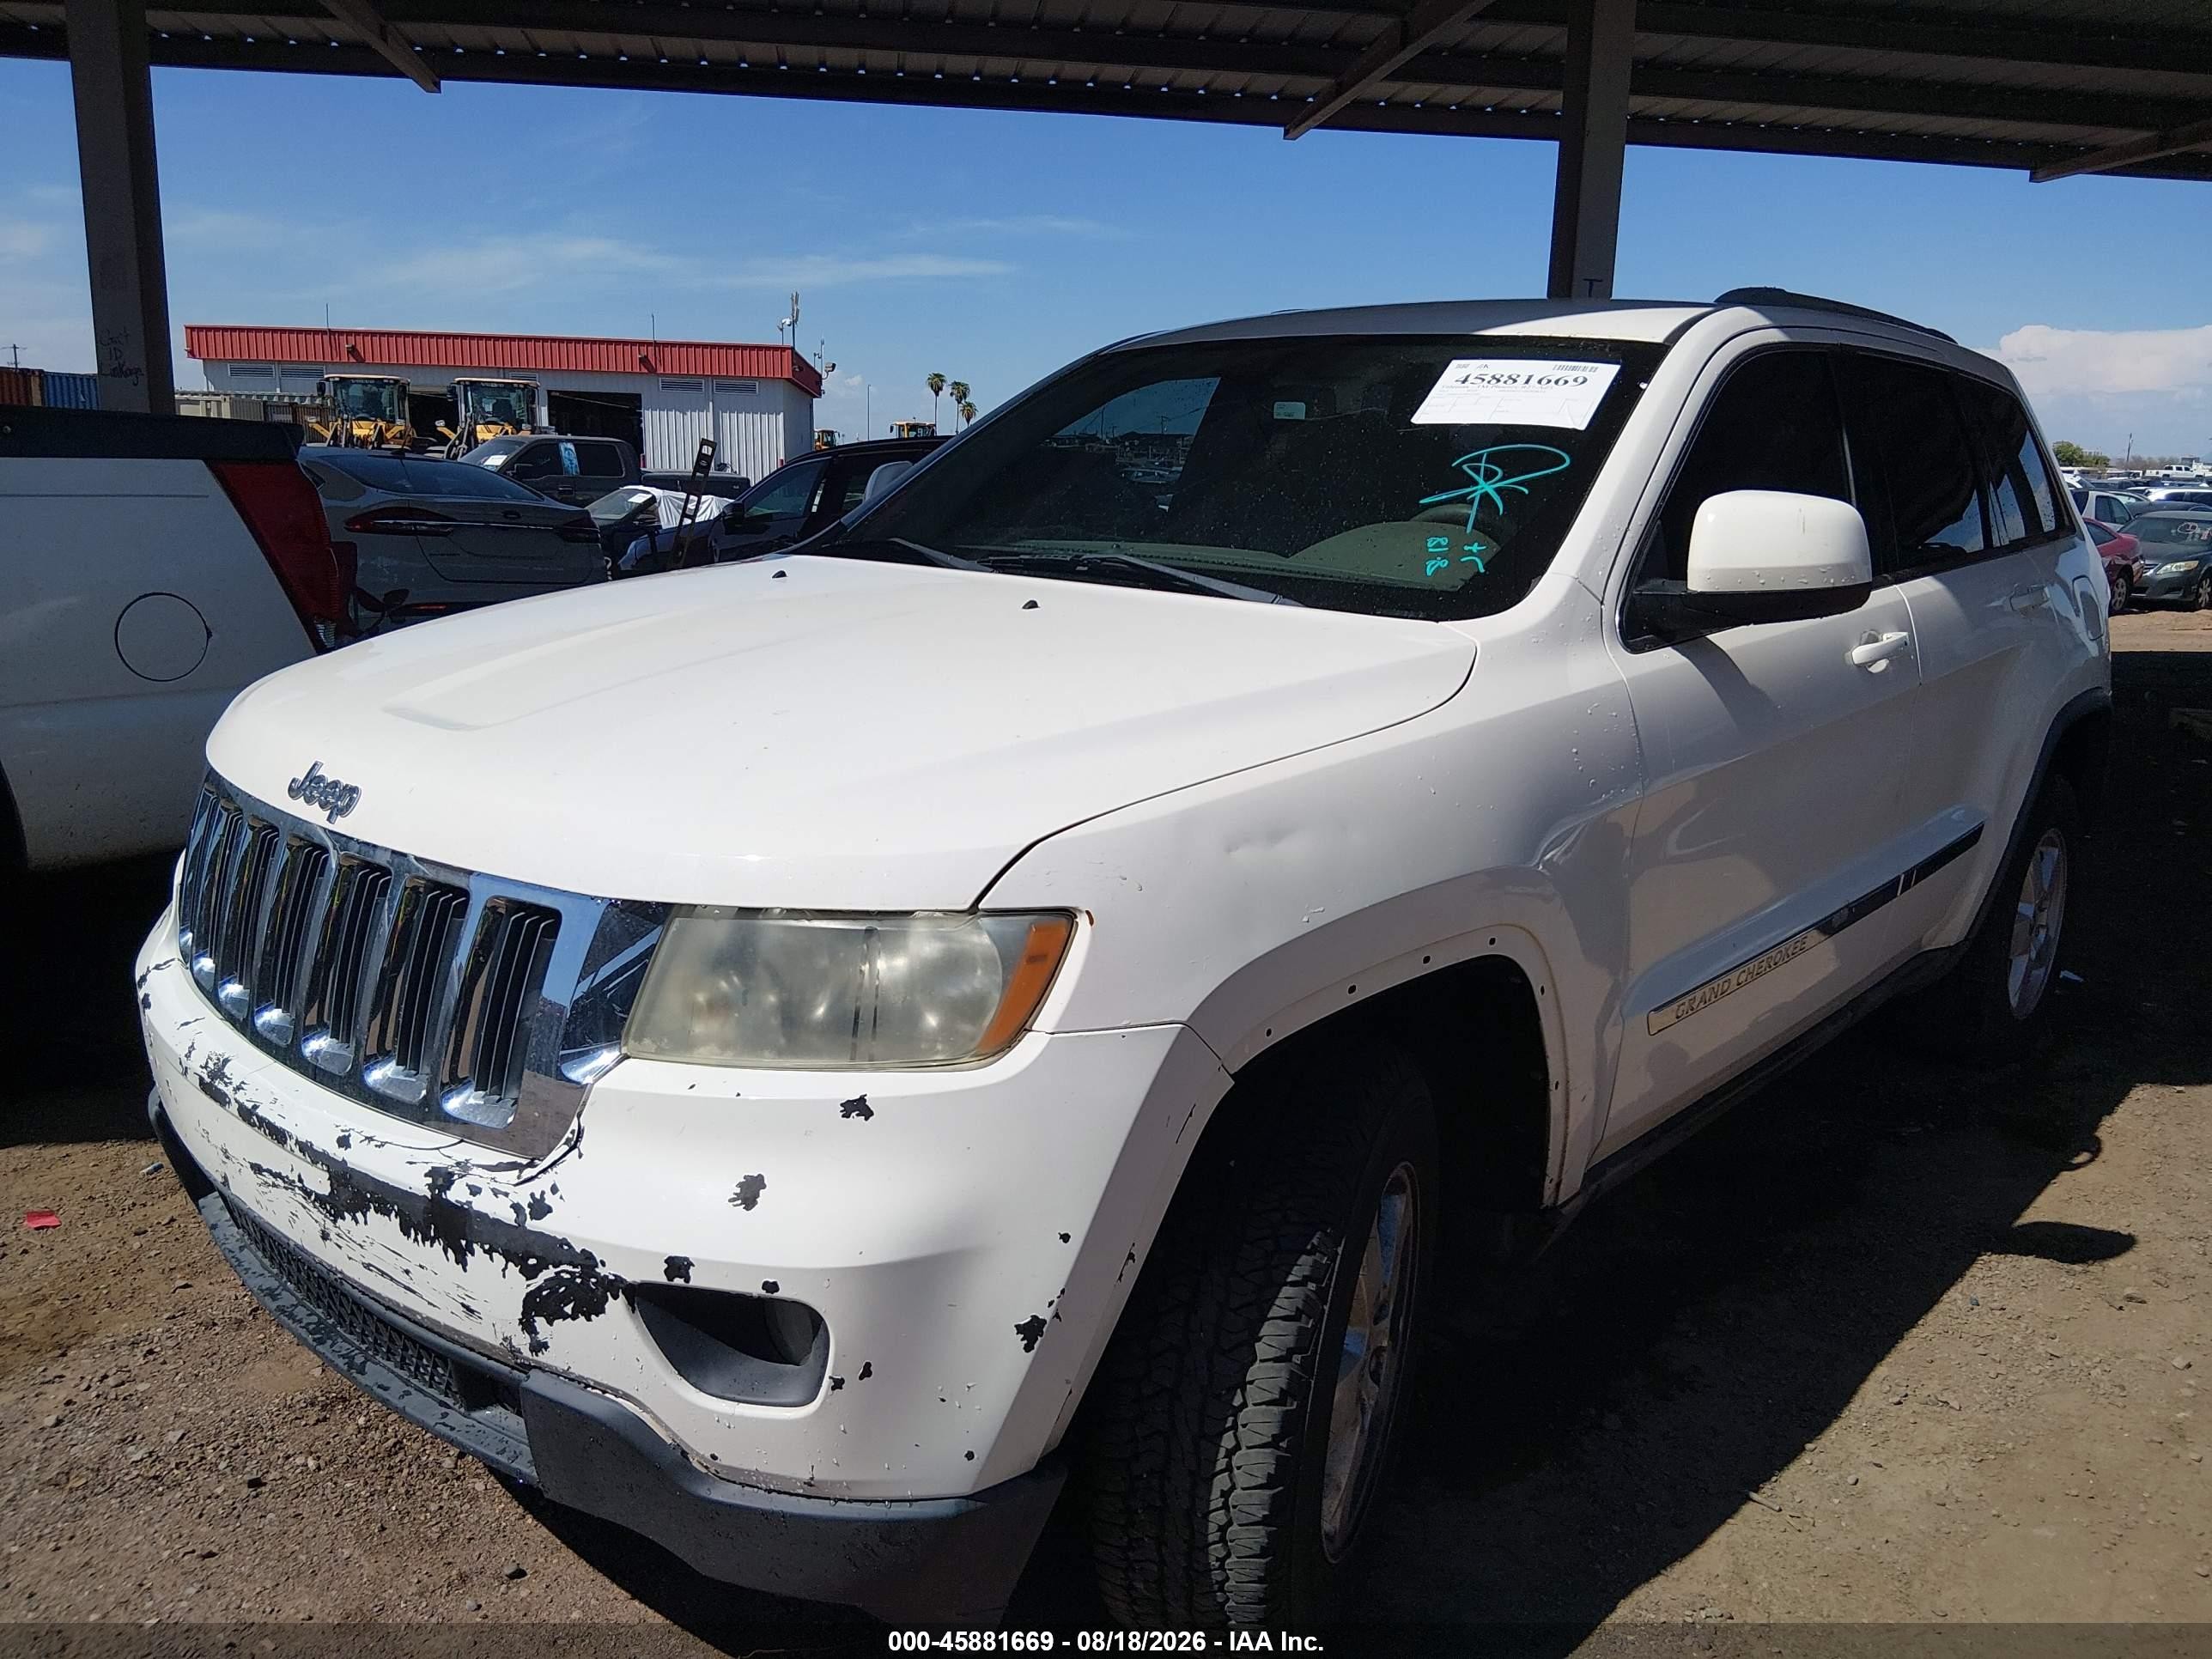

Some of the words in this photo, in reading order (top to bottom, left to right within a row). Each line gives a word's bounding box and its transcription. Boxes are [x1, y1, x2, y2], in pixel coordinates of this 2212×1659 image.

[1455, 372, 1589, 387] 45881669
[288, 761, 362, 825] Jeep
[1674, 980, 1731, 1019] GRAND
[1735, 936, 1808, 987] CHEROKEE
